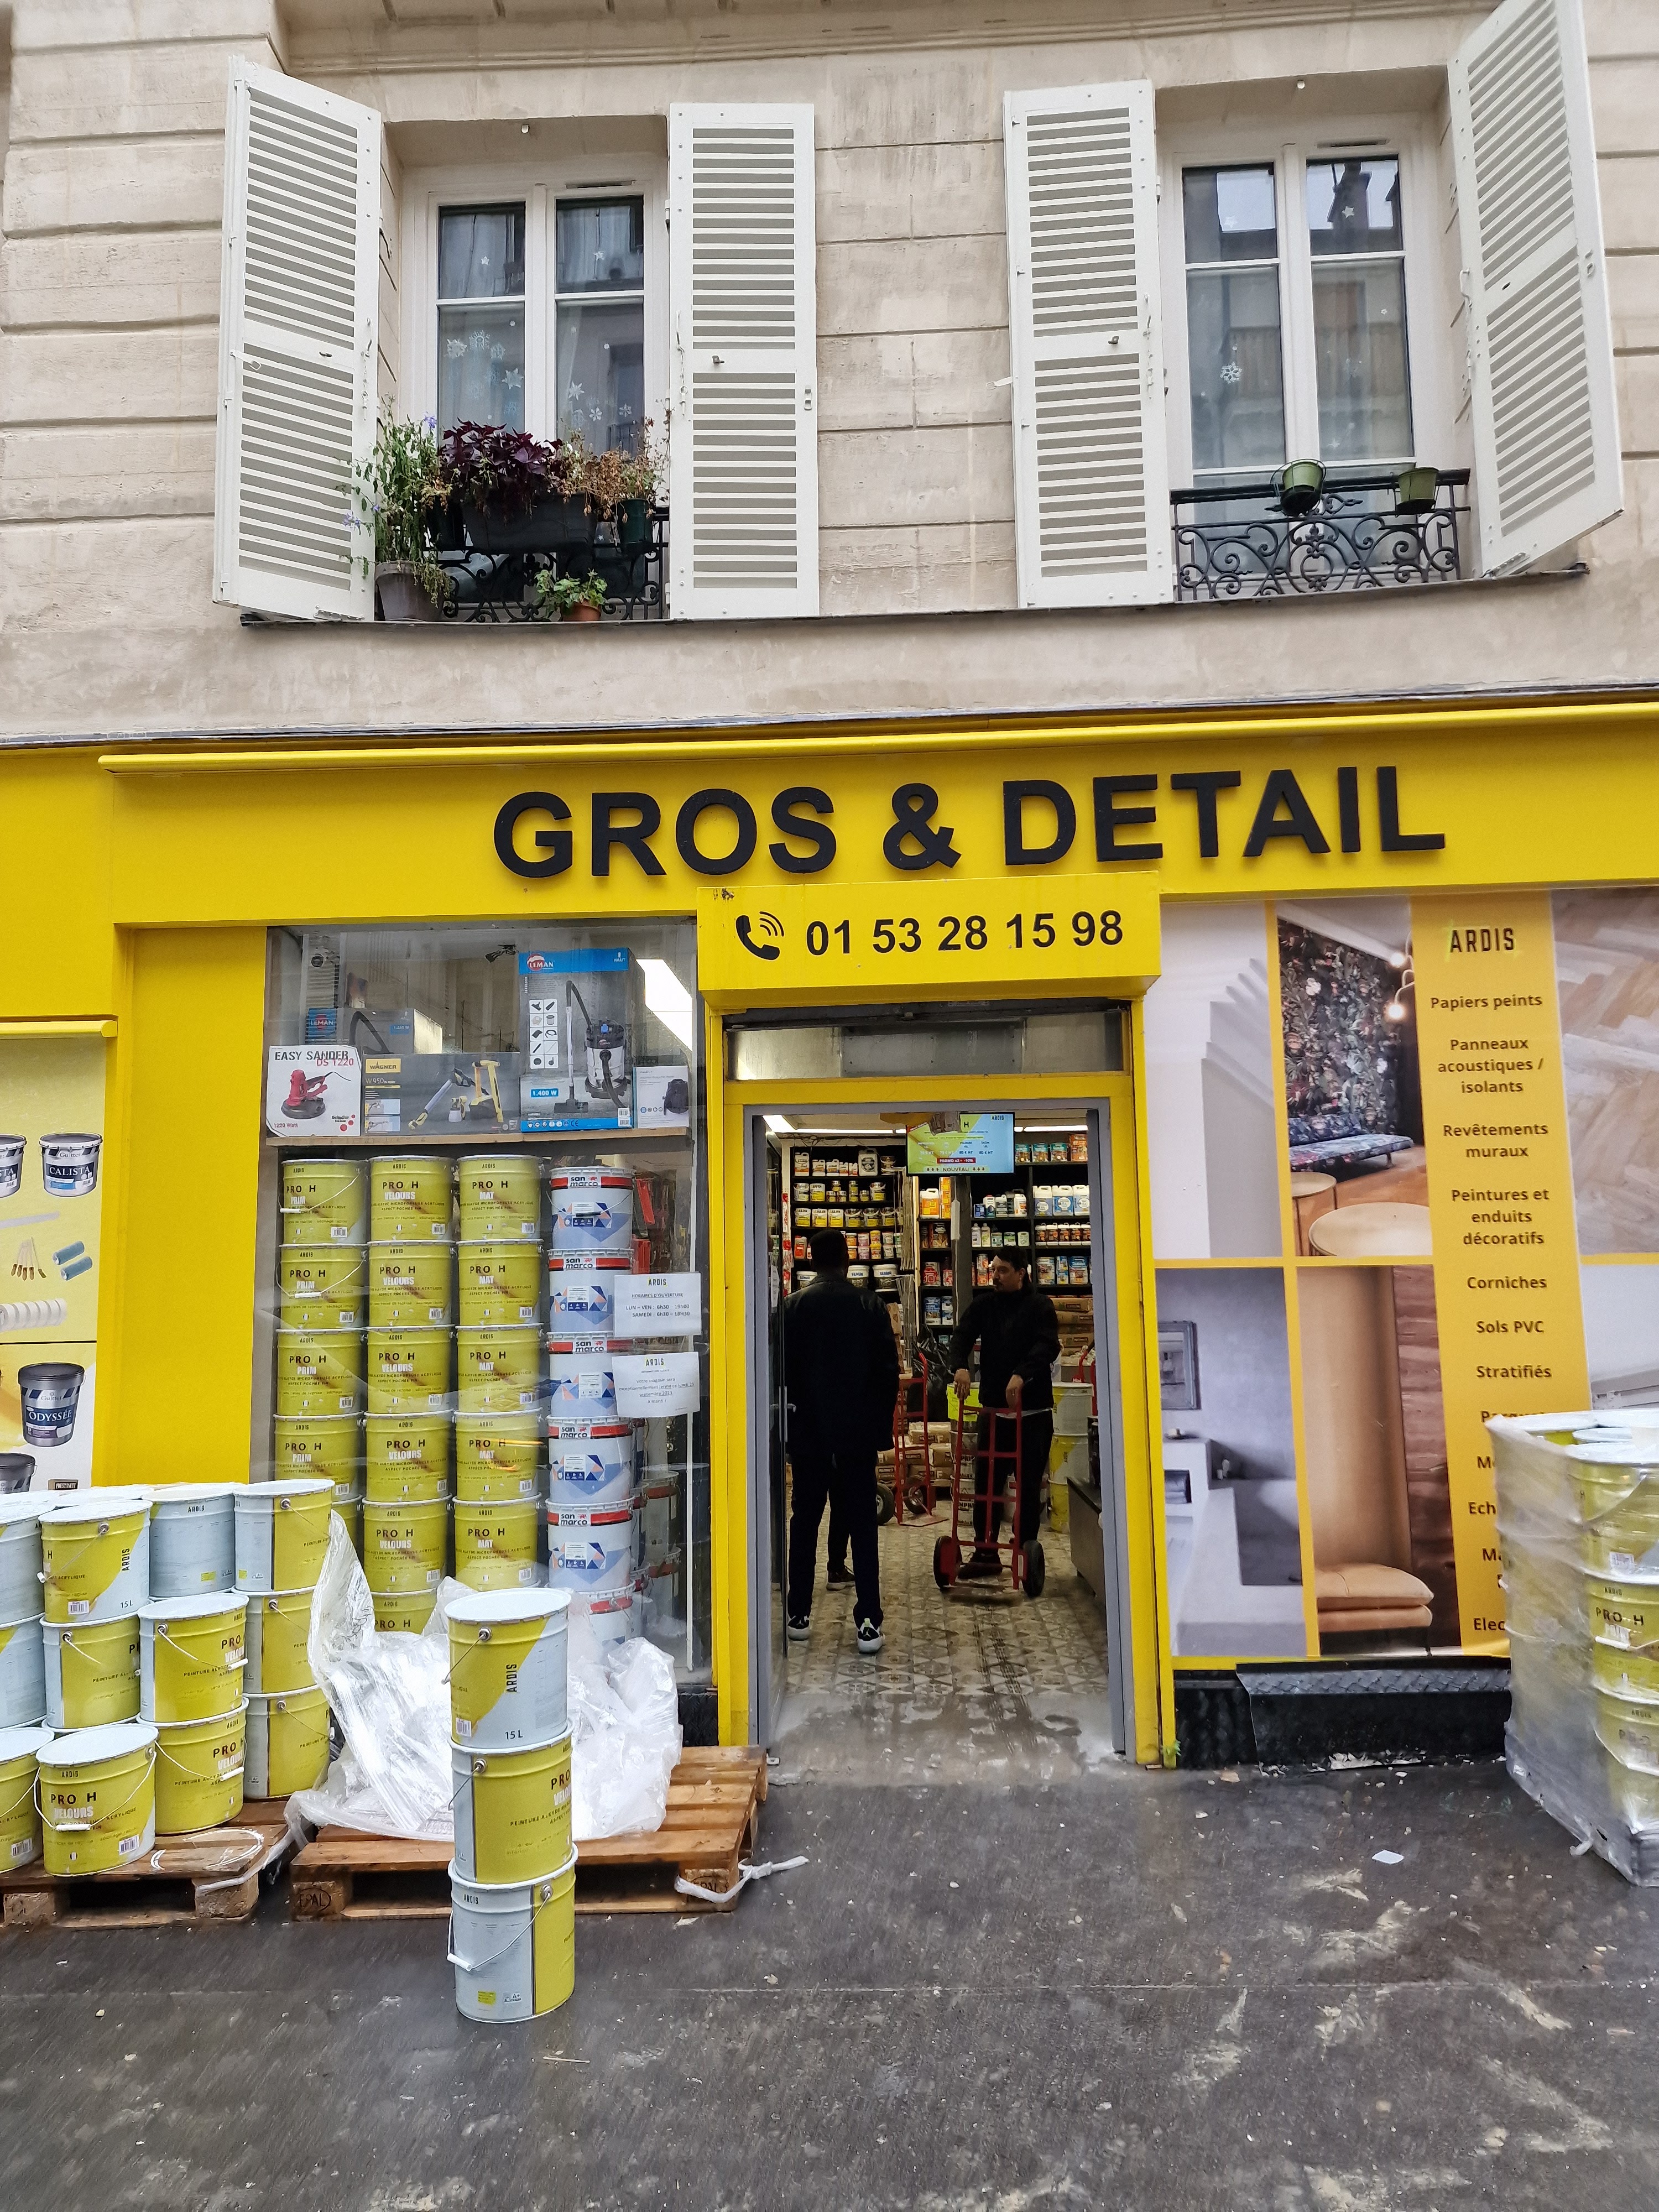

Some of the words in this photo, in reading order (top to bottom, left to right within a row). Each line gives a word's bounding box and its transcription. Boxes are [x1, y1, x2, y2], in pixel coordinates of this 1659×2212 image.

[494, 787, 836, 878] GROS
[883, 783, 961, 869] &
[1003, 766, 1444, 865] DETAIL
[807, 920, 849, 955] 01
[874, 918, 921, 953] 53
[939, 916, 987, 950] 28
[1007, 914, 1055, 948] 15
[1073, 911, 1122, 946] 98
[1450, 928, 1514, 953] ARDIS
[1431, 996, 1488, 1011] Papiers
[1493, 994, 1542, 1010] peints
[1451, 1039, 1528, 1050] Panneaux
[274, 1051, 302, 1061] EASY
[306, 1051, 348, 1060] SANDER
[332, 1058, 354, 1066] 1220
[1438, 1058, 1533, 1074] acoustiques
[1537, 1057, 1544, 1070] /
[1462, 1081, 1524, 1093] isolants
[1443, 1124, 1548, 1136] Revêtements
[1466, 1146, 1528, 1157] muraux
[49, 1166, 90, 1176] CALISTA
[472, 1181, 493, 1189] PRO
[384, 1191, 416, 1200] VELOURS
[1452, 1189, 1528, 1201] Peintures
[1533, 1189, 1550, 1200] et
[1472, 1210, 1532, 1223] enduits
[1463, 1232, 1545, 1245] décoratifs
[318, 1269, 326, 1277] H
[408, 1266, 415, 1274] H
[498, 1265, 505, 1273] H
[383, 1277, 414, 1286] VELOURS
[479, 1275, 494, 1284] MAT
[1467, 1276, 1547, 1289] Corniches
[296, 1281, 315, 1289] PRIM
[1477, 1320, 1508, 1333] Sols
[1514, 1321, 1545, 1333] PVC
[289, 1355, 311, 1364] PRO
[319, 1355, 326, 1363] H
[408, 1352, 415, 1360] H
[469, 1352, 491, 1360] PRO
[499, 1351, 506, 1359] H
[479, 1361, 494, 1370] MAT
[646, 1358, 664, 1366] ARDIS
[297, 1366, 316, 1375] PRIM
[382, 1363, 413, 1373] VELOURS
[1477, 1365, 1552, 1378] Stratifiés
[29, 1408, 72, 1421] ODYSSÉE
[285, 1442, 306, 1451] PRO
[314, 1442, 322, 1451] H
[387, 1440, 410, 1448] PRO
[418, 1439, 425, 1448] H
[469, 1439, 491, 1448] PRO
[293, 1453, 312, 1462] PRIM
[388, 1449, 422, 1460] VELOURS
[479, 1450, 495, 1459] MAT
[376, 1528, 398, 1538] PRO
[406, 1528, 413, 1537] H
[468, 1528, 490, 1537] PRO
[498, 1527, 505, 1536] H
[379, 1540, 412, 1549] VELOURS
[478, 1539, 493, 1548] MAT
[48, 1550, 53, 1559] H
[121, 1548, 130, 1571] ARDIS
[1595, 1606, 1623, 1623] PRO
[1633, 1614, 1644, 1626] H
[375, 1619, 395, 1629] PRO
[403, 1619, 410, 1628] H
[221, 1635, 241, 1650] PRO
[506, 1663, 518, 1693] ARDIS
[505, 1730, 515, 1740] 15
[518, 1729, 524, 1738] L
[213, 1741, 236, 1758] PRO
[551, 1769, 570, 1790] PRO
[51, 1793, 76, 1804] PRO
[87, 1791, 96, 1803] H
[54, 1806, 94, 1819] VELOURS
[106, 1807, 136, 1820] ACRYLIQUE
[510, 1815, 539, 1826] PEINTURE
[463, 1893, 479, 1905] ARDIS
